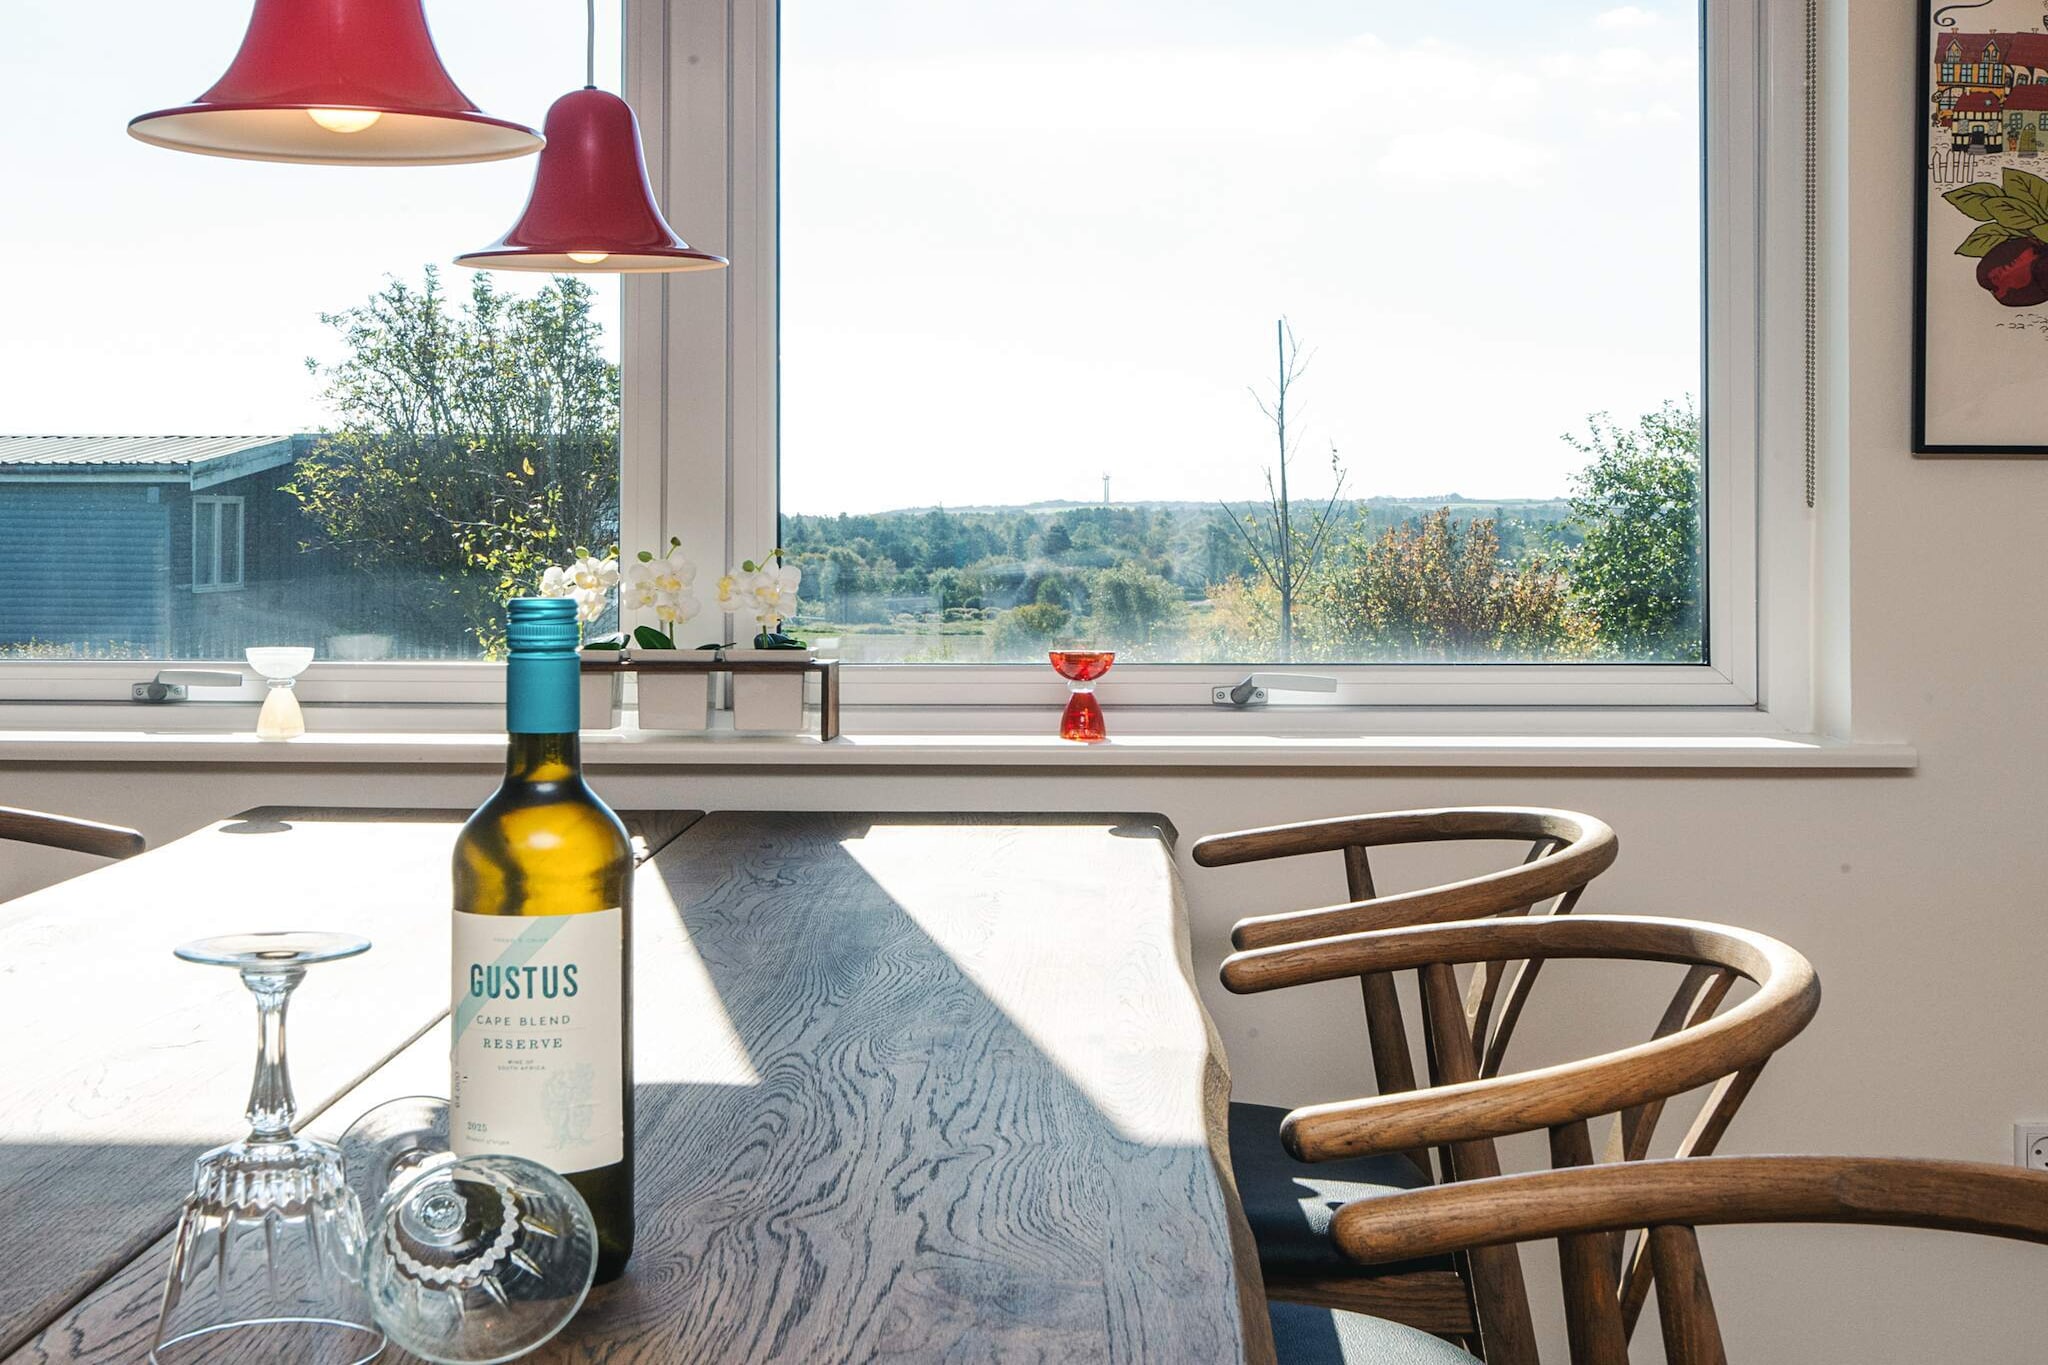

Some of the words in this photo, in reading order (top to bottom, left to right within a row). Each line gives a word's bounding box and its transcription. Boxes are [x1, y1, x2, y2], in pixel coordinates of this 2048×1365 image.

[470, 963, 578, 999] GUSTUS
[476, 1015, 511, 1026] CAPE
[519, 1015, 571, 1026] BLEND
[483, 1038, 562, 1049] RESERVE
